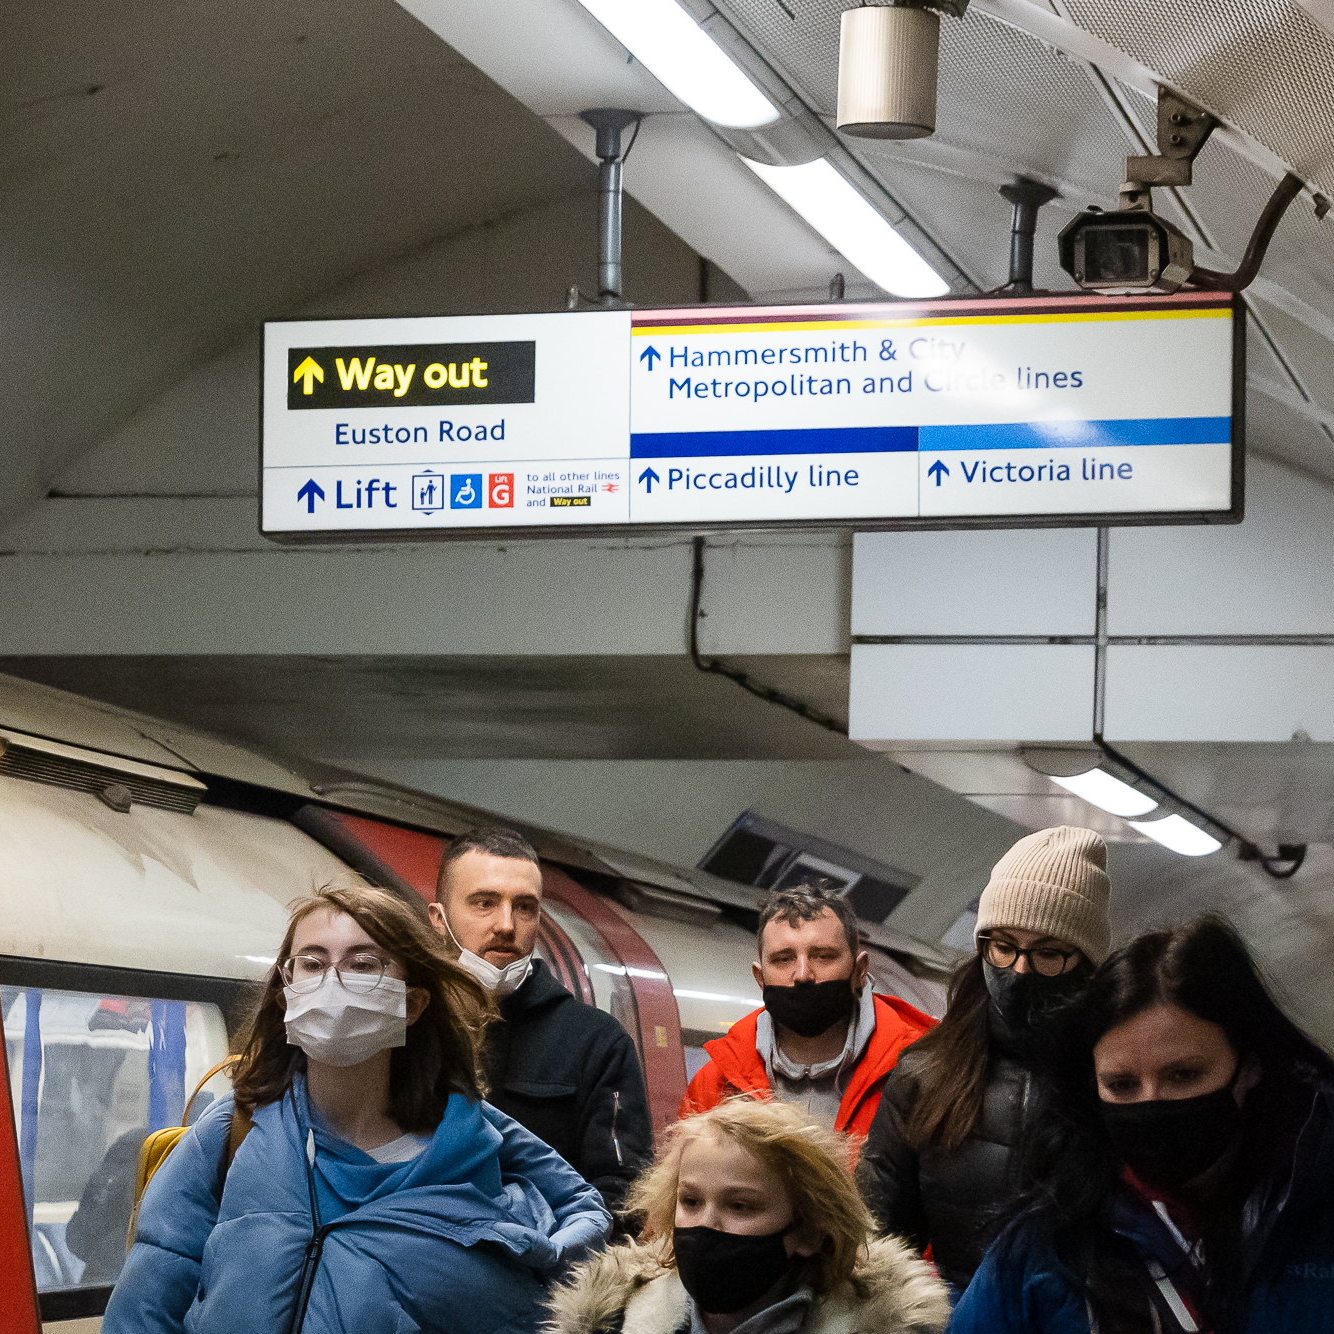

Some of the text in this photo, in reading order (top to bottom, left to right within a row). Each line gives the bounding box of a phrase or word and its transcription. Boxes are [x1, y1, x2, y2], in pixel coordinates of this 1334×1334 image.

[669, 337, 966, 369] Hammersmith & City
[335, 357, 489, 397] Way out
[668, 366, 1084, 403] Metropolitan and Circle lines
[335, 419, 506, 445] Euston Road
[527, 470, 620, 481] to all other lines
[667, 464, 860, 494] Piccadilly line
[960, 457, 1134, 485] Victoria line
[336, 478, 398, 509] Lift
[492, 485, 510, 506] G
[526, 497, 588, 507] and Way out
[527, 483, 598, 494] National Rail
